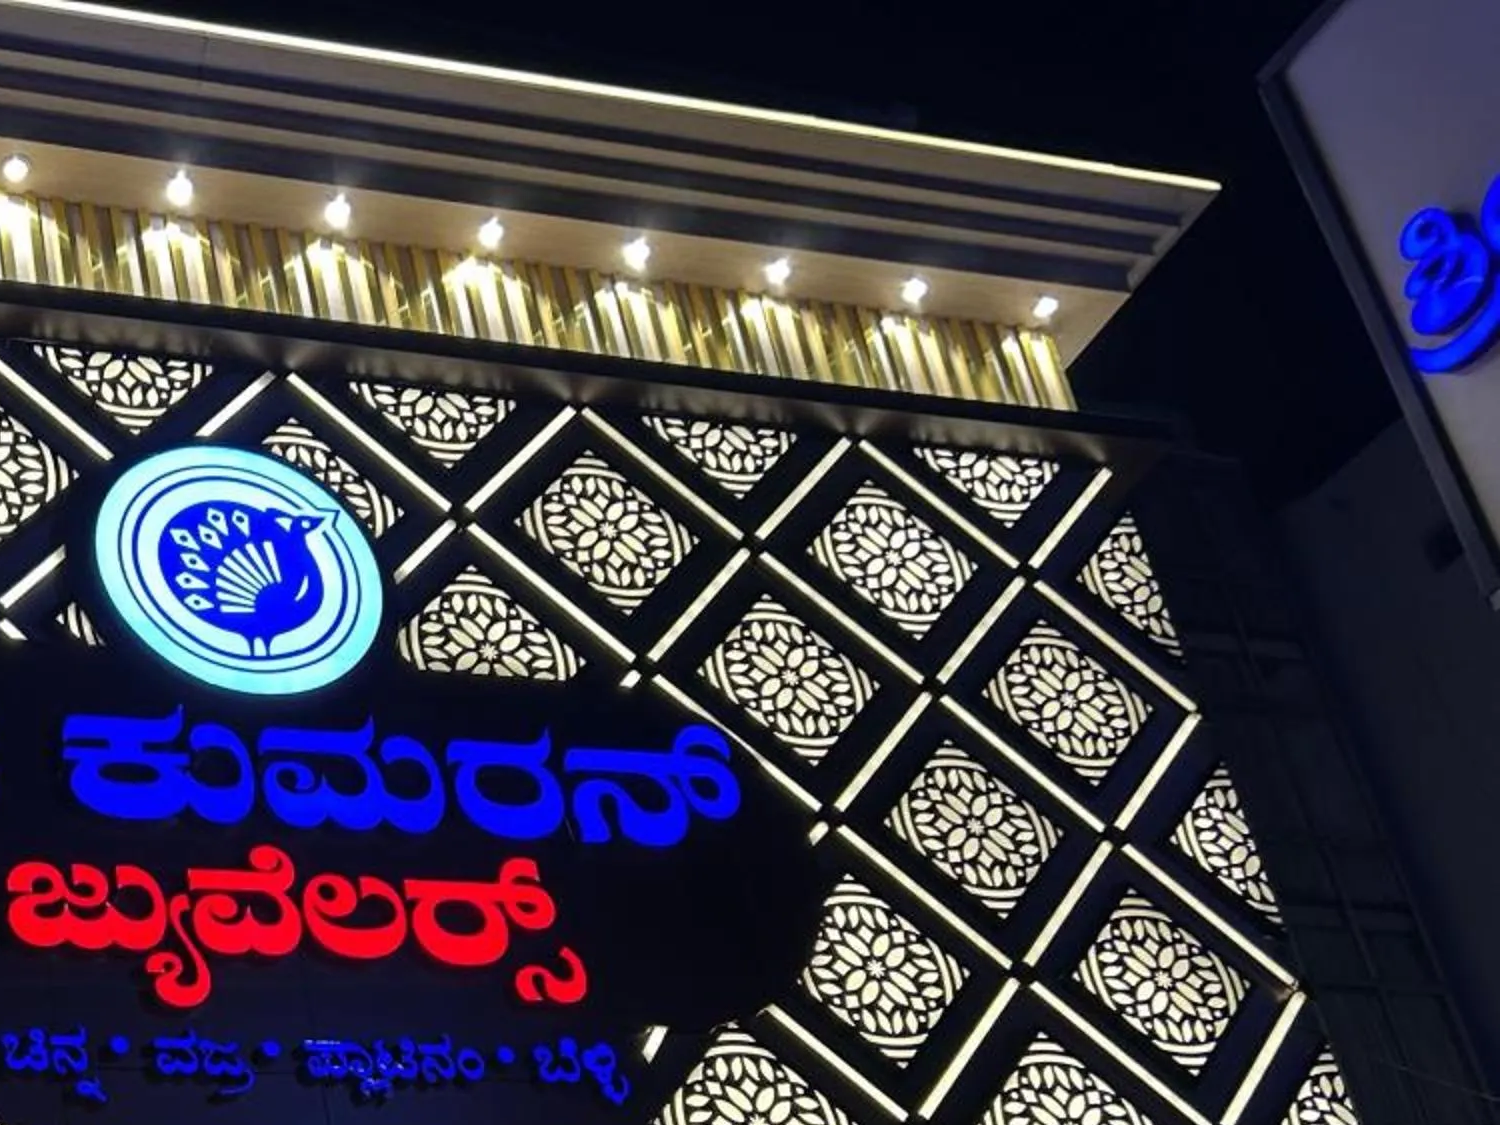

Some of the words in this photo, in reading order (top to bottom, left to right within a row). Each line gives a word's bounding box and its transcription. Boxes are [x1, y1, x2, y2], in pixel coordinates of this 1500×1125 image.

[62, 704, 742, 849] ಕುಮರನ್
[7, 845, 587, 1008] ಜ್ಯುವೆಲರ್ಸ್
[1, 1027, 106, 1101] ಚಿನ್ನ
[153, 1031, 256, 1093] ವಜ್ರ
